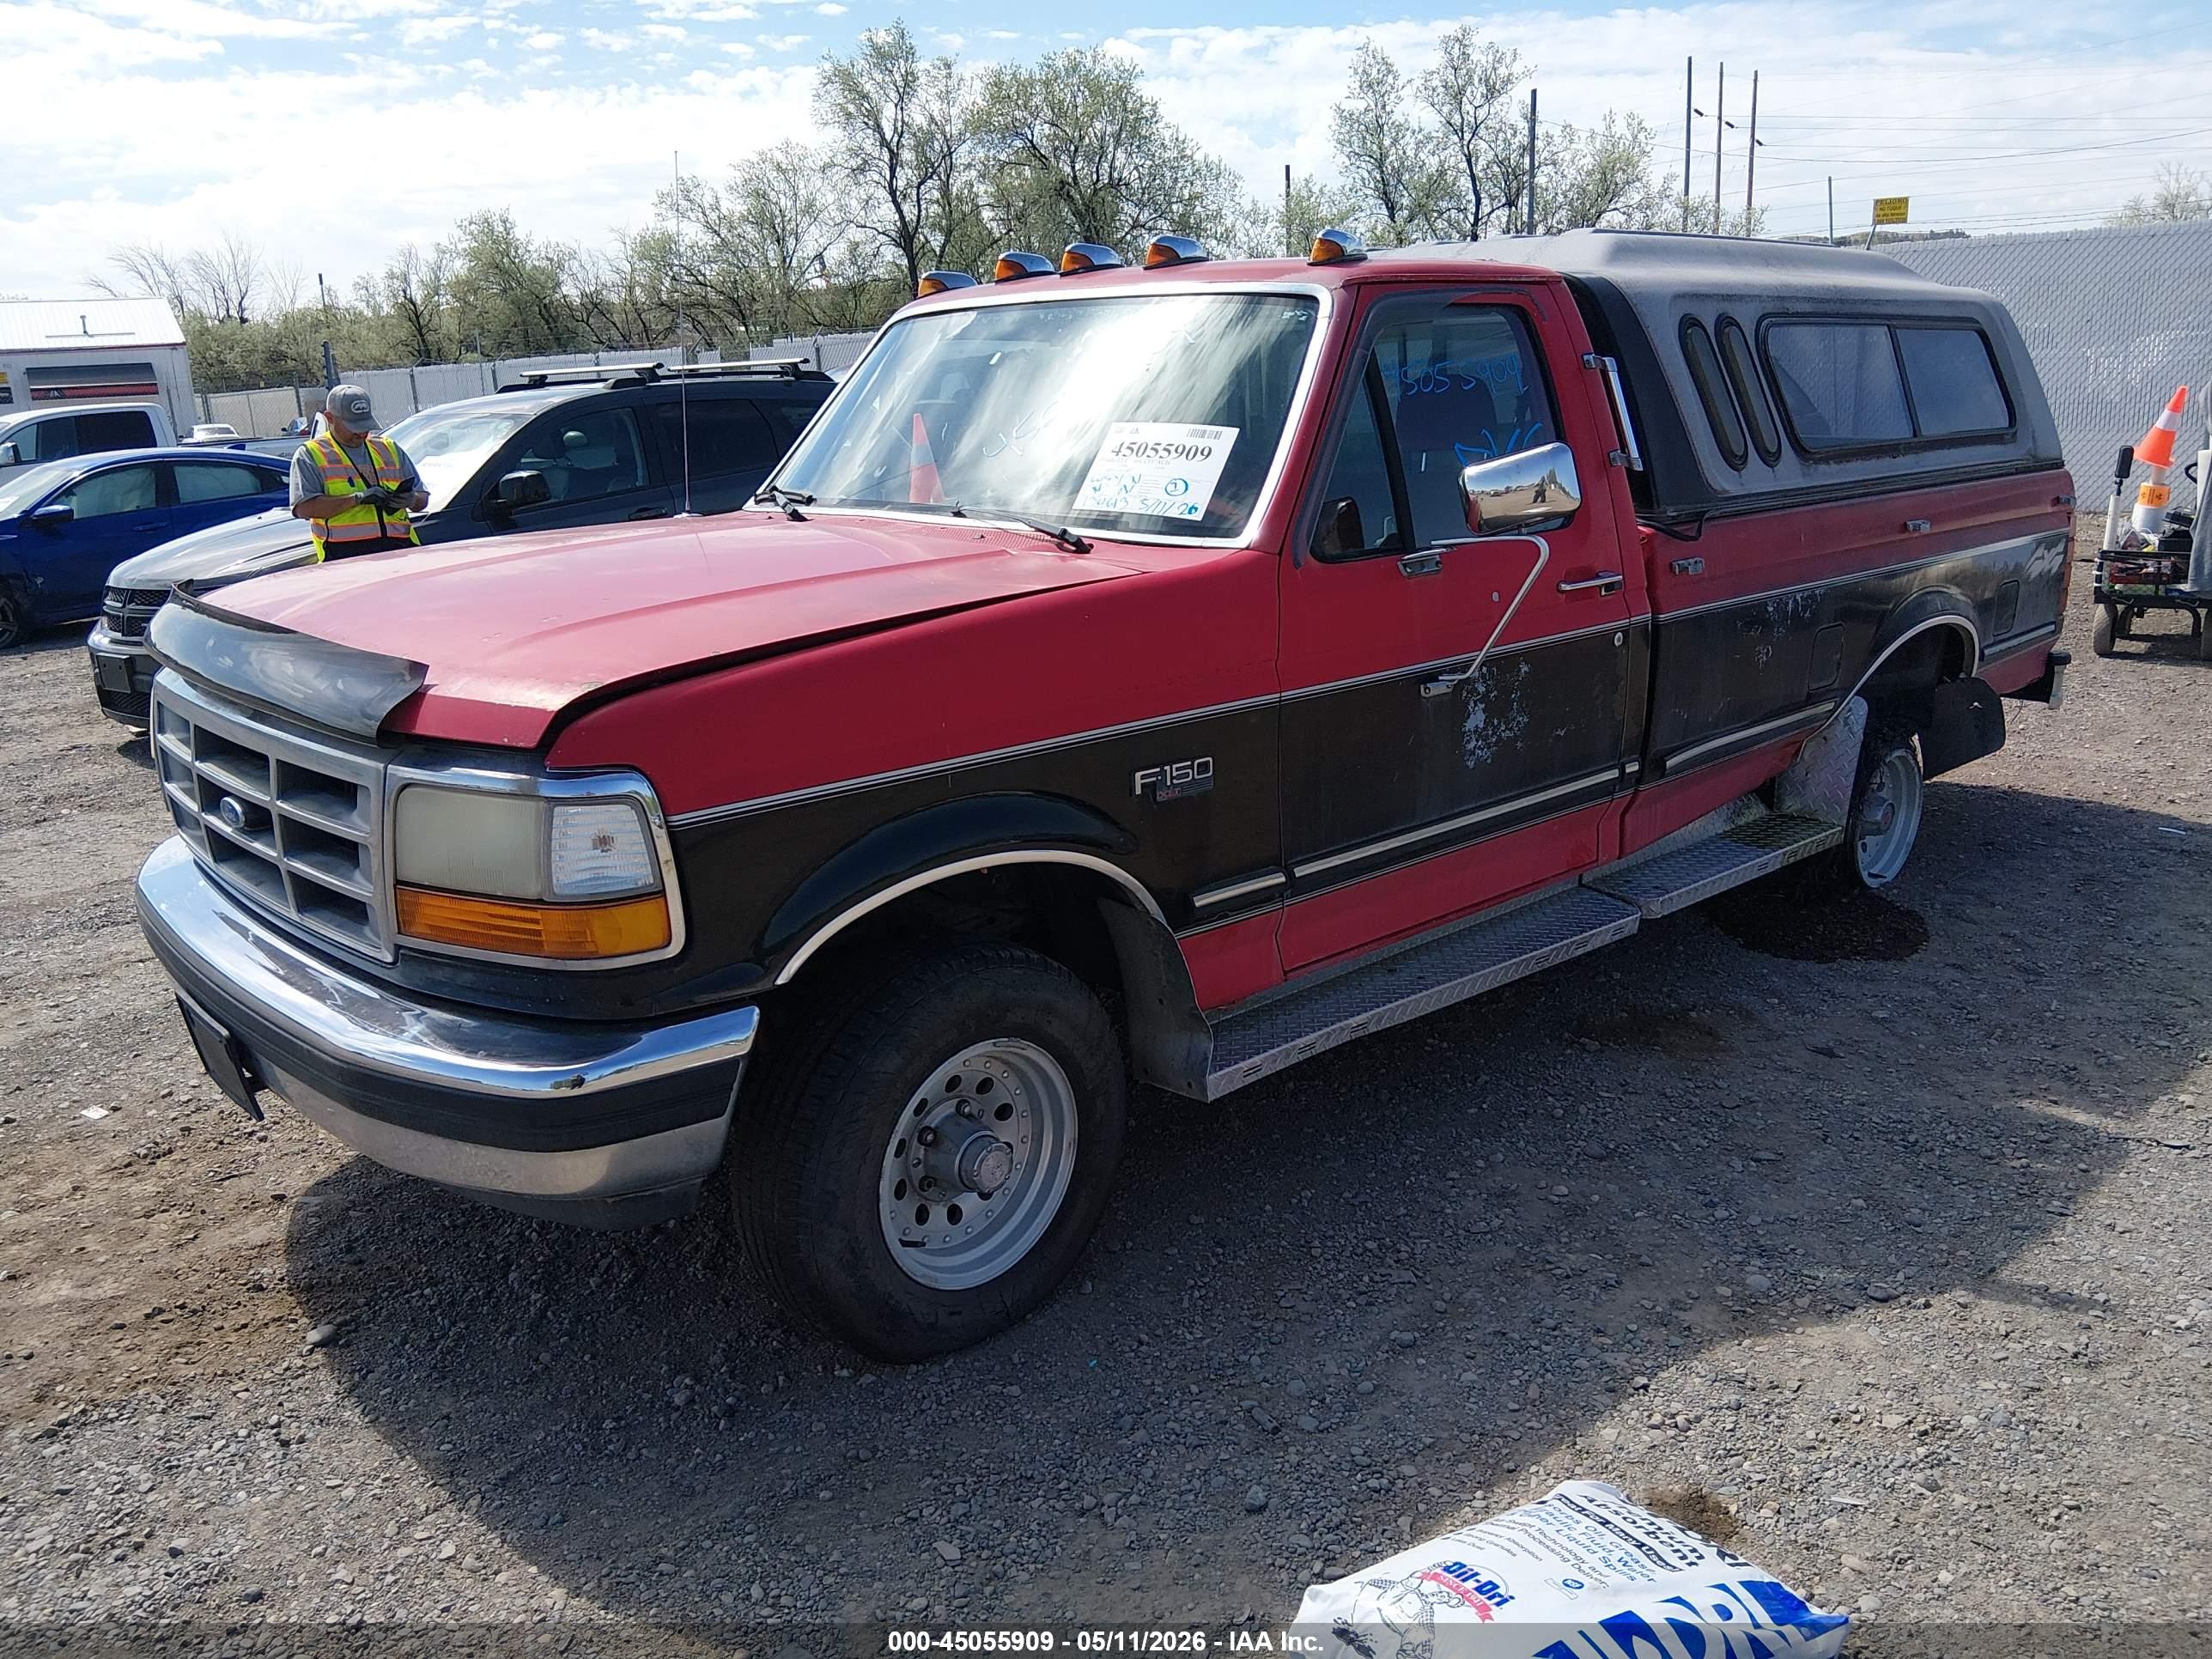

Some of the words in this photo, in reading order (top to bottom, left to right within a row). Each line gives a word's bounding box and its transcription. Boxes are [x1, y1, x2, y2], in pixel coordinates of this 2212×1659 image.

[1111, 441, 1212, 462] 45055909
[1517, 1528, 1571, 1564] Processing
[1534, 1526, 1589, 1565] Technology
[1577, 1494, 1699, 1567] Absorbent
[1584, 1510, 1607, 1525] For
[1606, 1522, 1641, 1547] Many
[1555, 1528, 1598, 1555] Liquid
[1598, 1555, 1638, 1582] Spills
[1578, 1531, 1614, 1557] Fluid,
[1617, 1555, 1657, 1583] Water
[1441, 1561, 1516, 1607] Oil-Dri
